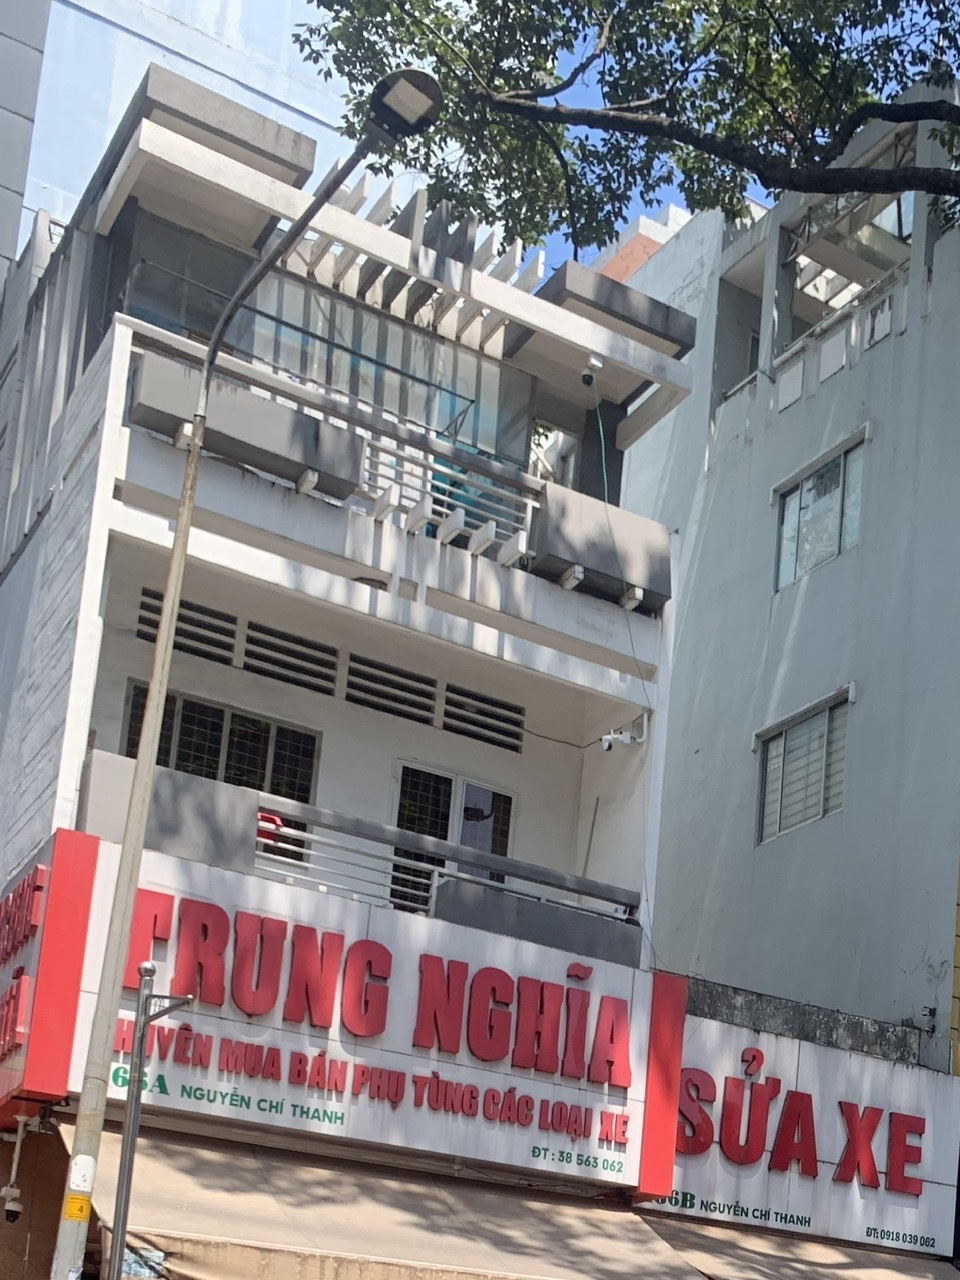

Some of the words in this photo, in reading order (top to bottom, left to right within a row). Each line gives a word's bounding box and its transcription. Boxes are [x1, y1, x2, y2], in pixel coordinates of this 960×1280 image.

[123, 888, 393, 1037] TRUNG
[412, 961, 632, 1089] NGHĨA
[180, 1085, 251, 1110] NGUYỄN
[257, 1097, 284, 1115] CHÍ
[291, 1103, 344, 1126] THANH
[218, 1037, 282, 1081] MUA
[288, 1050, 348, 1094] BÁN
[352, 1063, 406, 1111] PHỤ
[412, 1071, 480, 1117] TÙNG
[483, 1086, 534, 1127] CÁC
[538, 1098, 594, 1142] LOẠI
[598, 1110, 629, 1144] XE
[676, 1046, 819, 1179] SỬA
[832, 1100, 926, 1197] XE
[557, 1149, 573, 1165] 38
[575, 1153, 599, 1169] 563
[602, 1158, 624, 1173] 062
[752, 1207, 772, 1222] CHÍ
[774, 1211, 812, 1228] THANH
[880, 1229, 901, 1242] 0918
[901, 1232, 919, 1245] 039
[919, 1235, 936, 1248] 062
